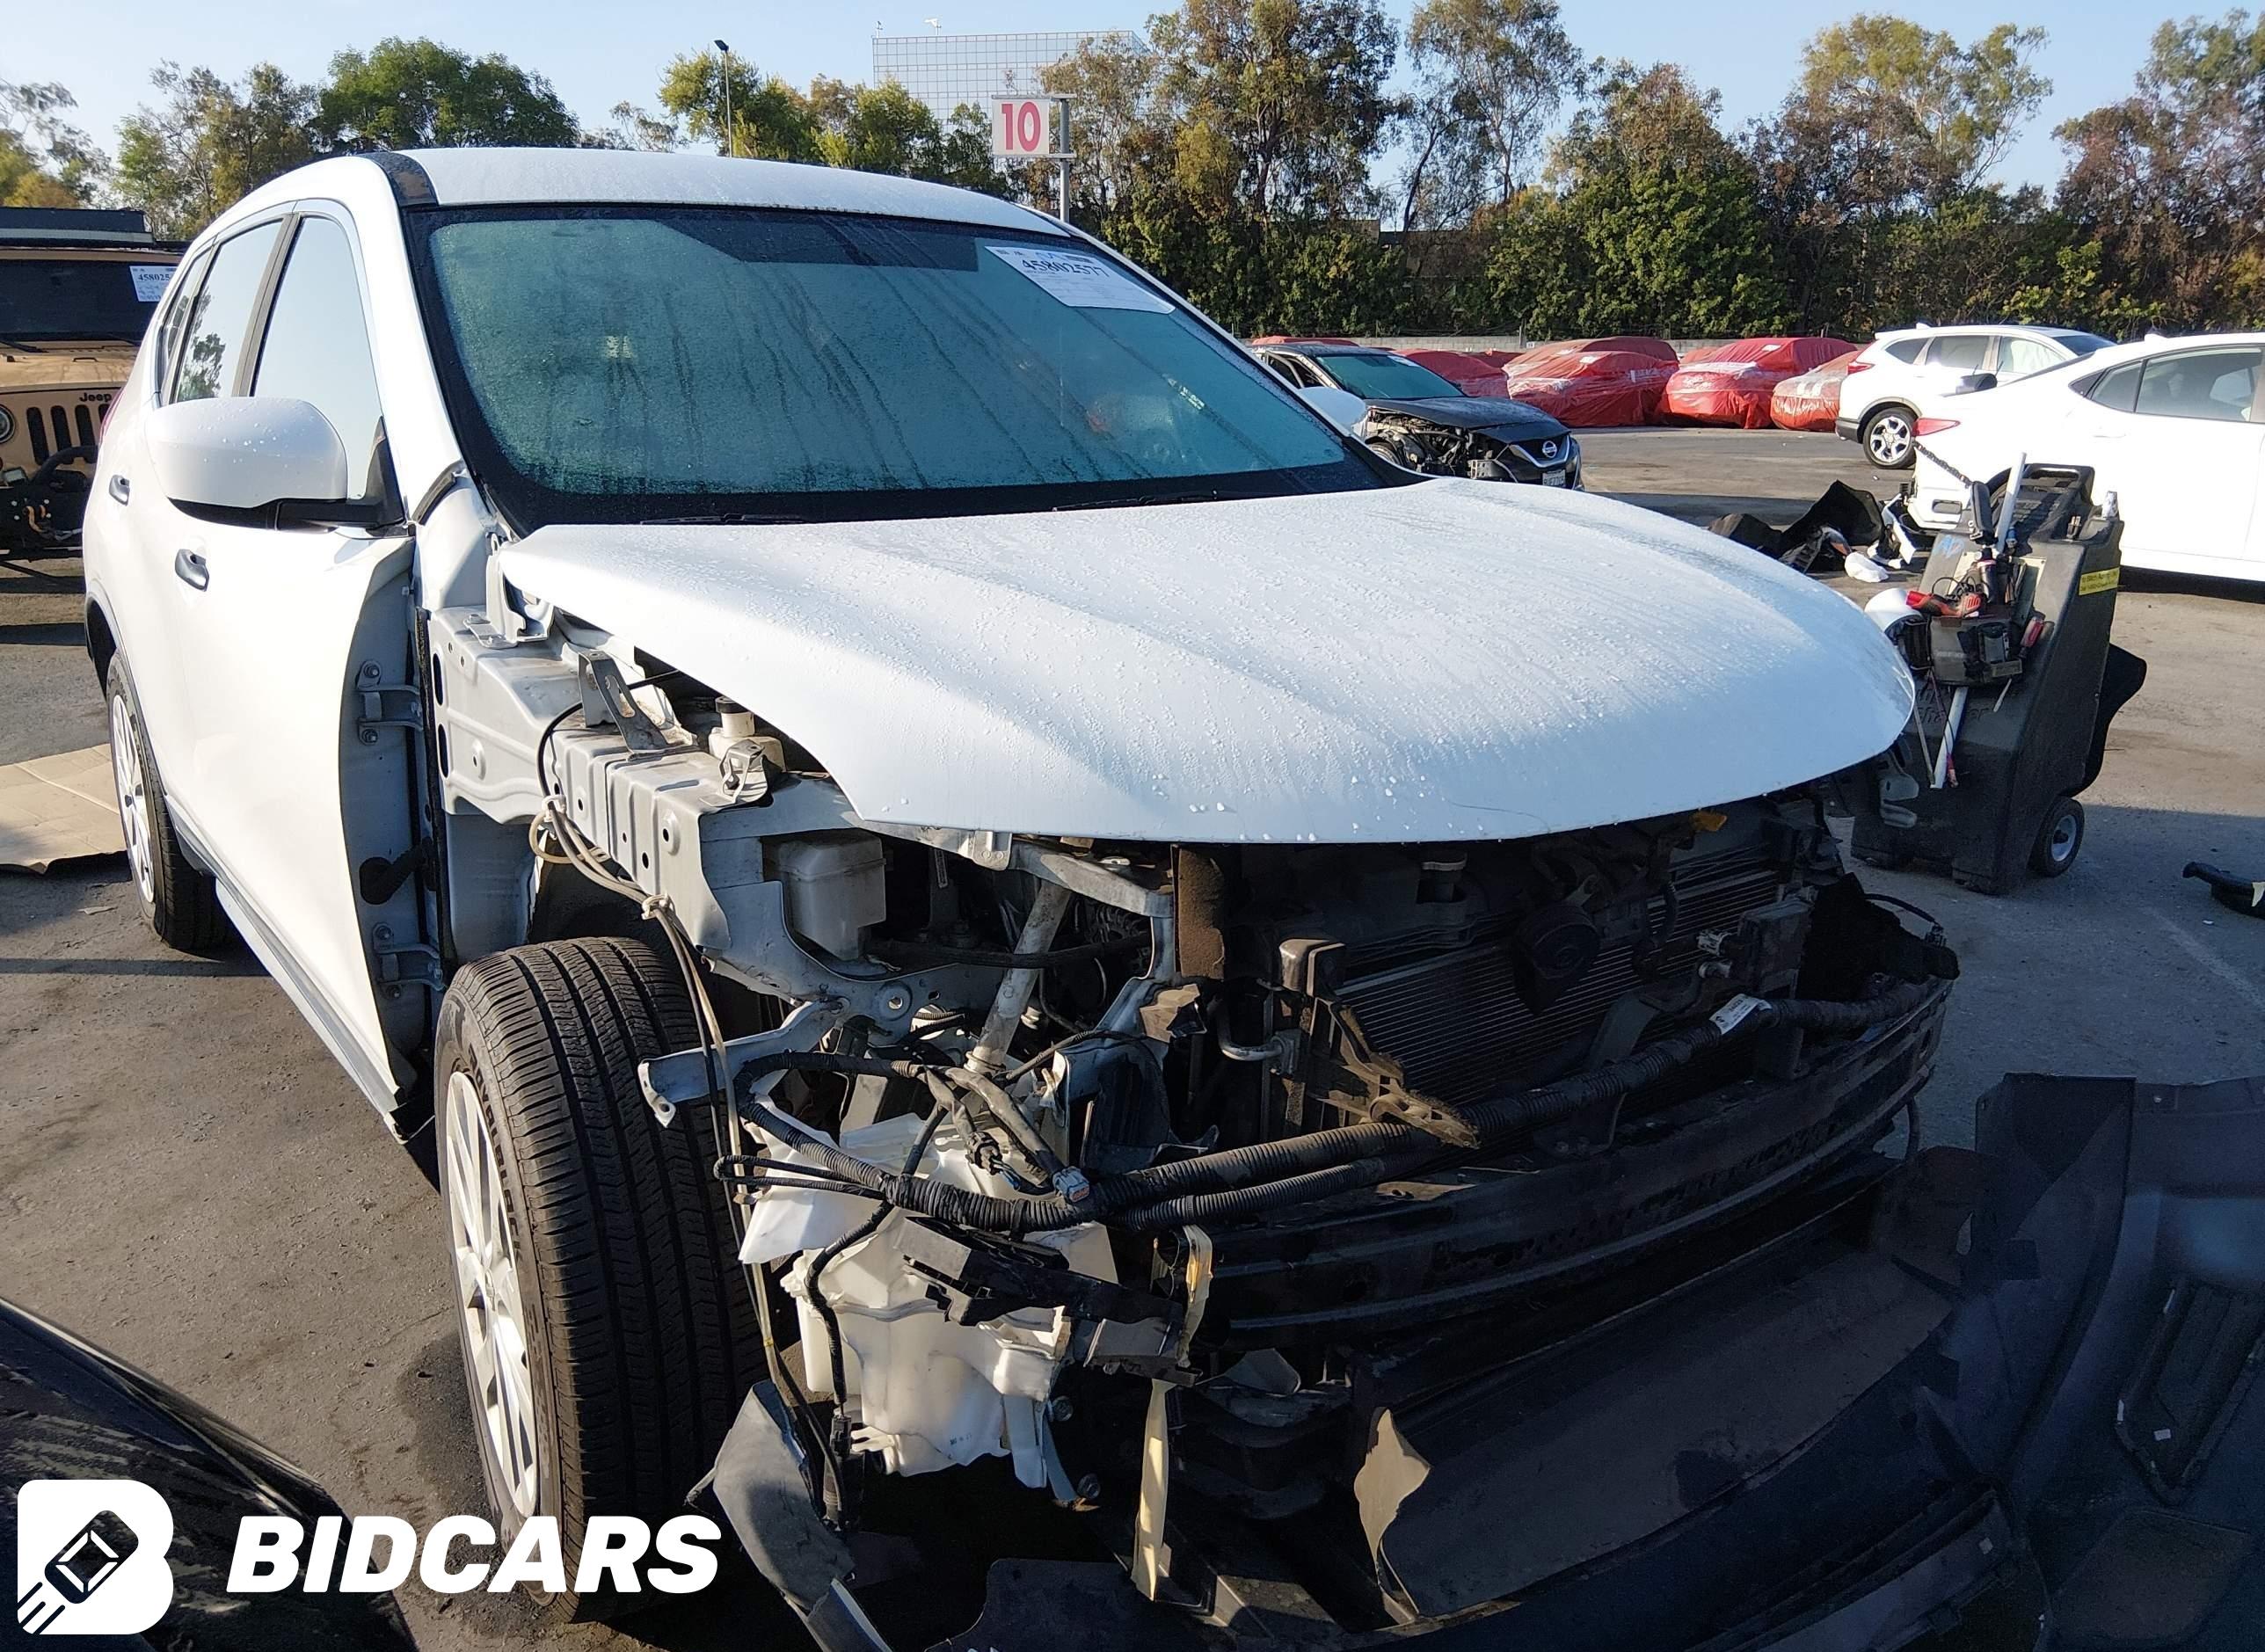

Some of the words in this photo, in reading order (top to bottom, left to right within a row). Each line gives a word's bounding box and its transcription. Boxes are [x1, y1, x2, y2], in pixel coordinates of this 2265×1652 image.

[1001, 101, 1041, 152] 10
[1022, 259, 1110, 278] 45802577
[79, 392, 113, 403] Jeep
